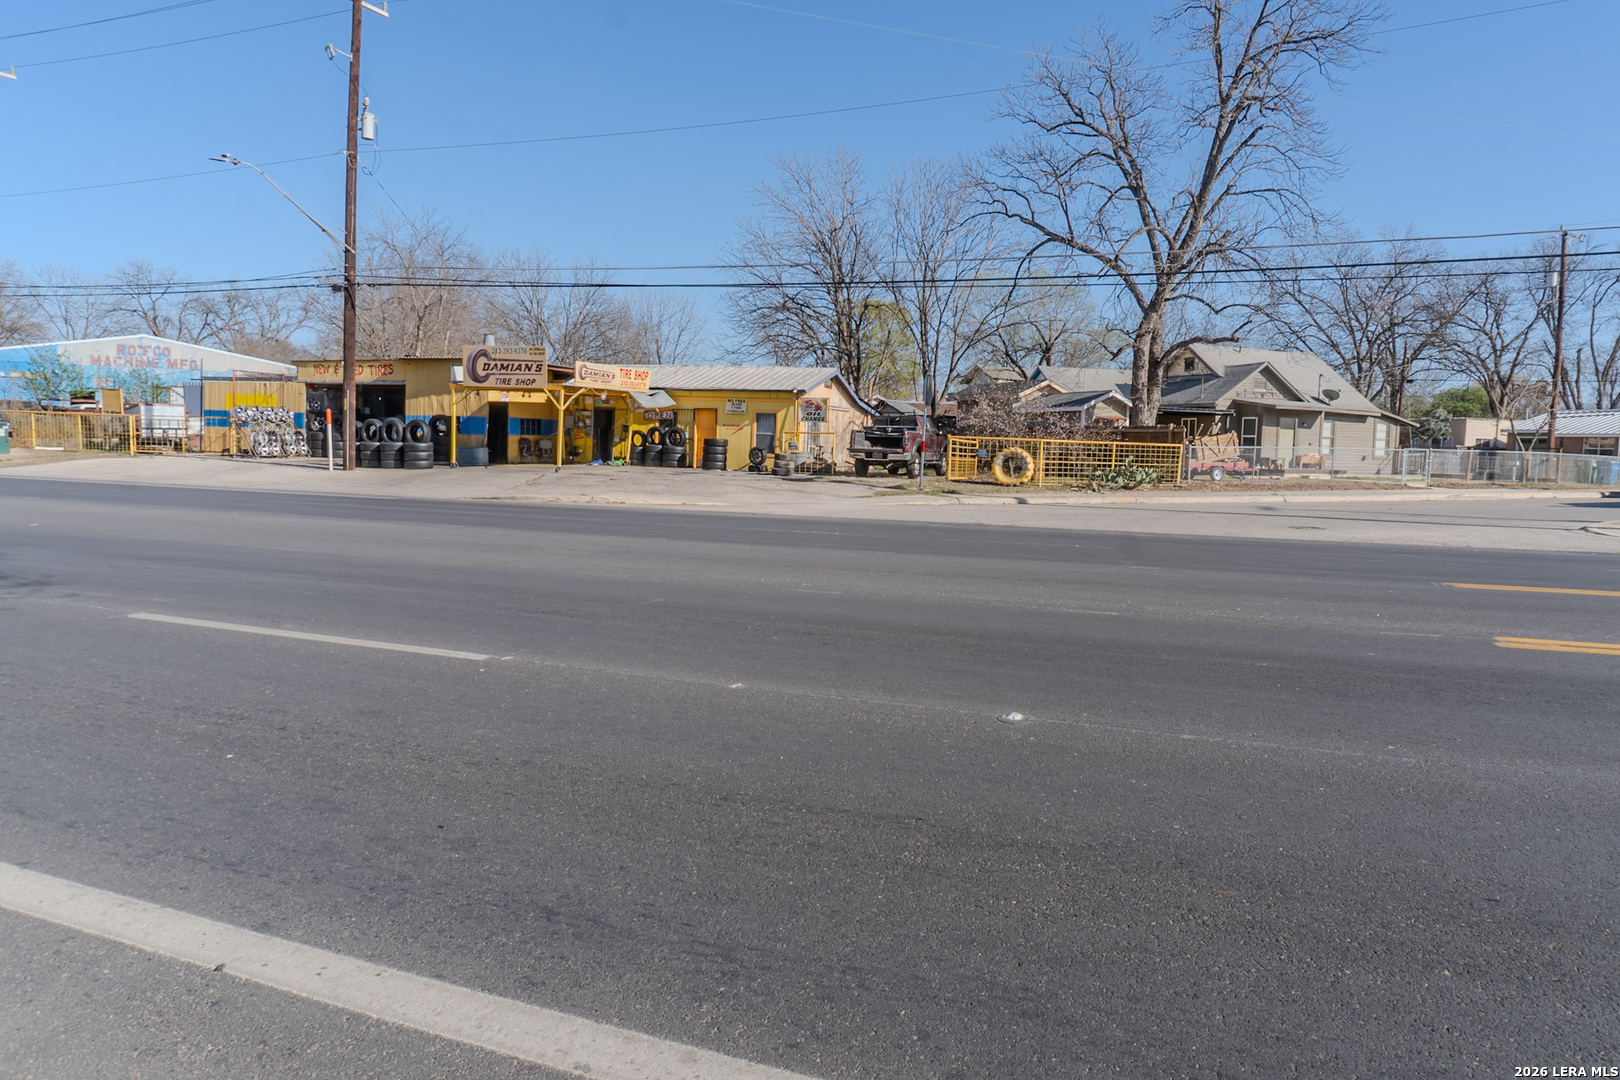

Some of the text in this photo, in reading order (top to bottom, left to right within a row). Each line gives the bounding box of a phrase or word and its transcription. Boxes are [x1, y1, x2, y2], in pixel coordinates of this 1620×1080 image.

[116, 343, 172, 358] ROTCO
[89, 354, 198, 371] MACHINE MFG
[482, 361, 544, 373] DAMIAN'S
[313, 363, 331, 376] NEW
[333, 362, 339, 377] &
[367, 363, 394, 376] TIRES
[619, 368, 650, 381] TIRE SHOP
[495, 377, 537, 386] TIRE SHOP
[646, 410, 672, 420] OPEN
